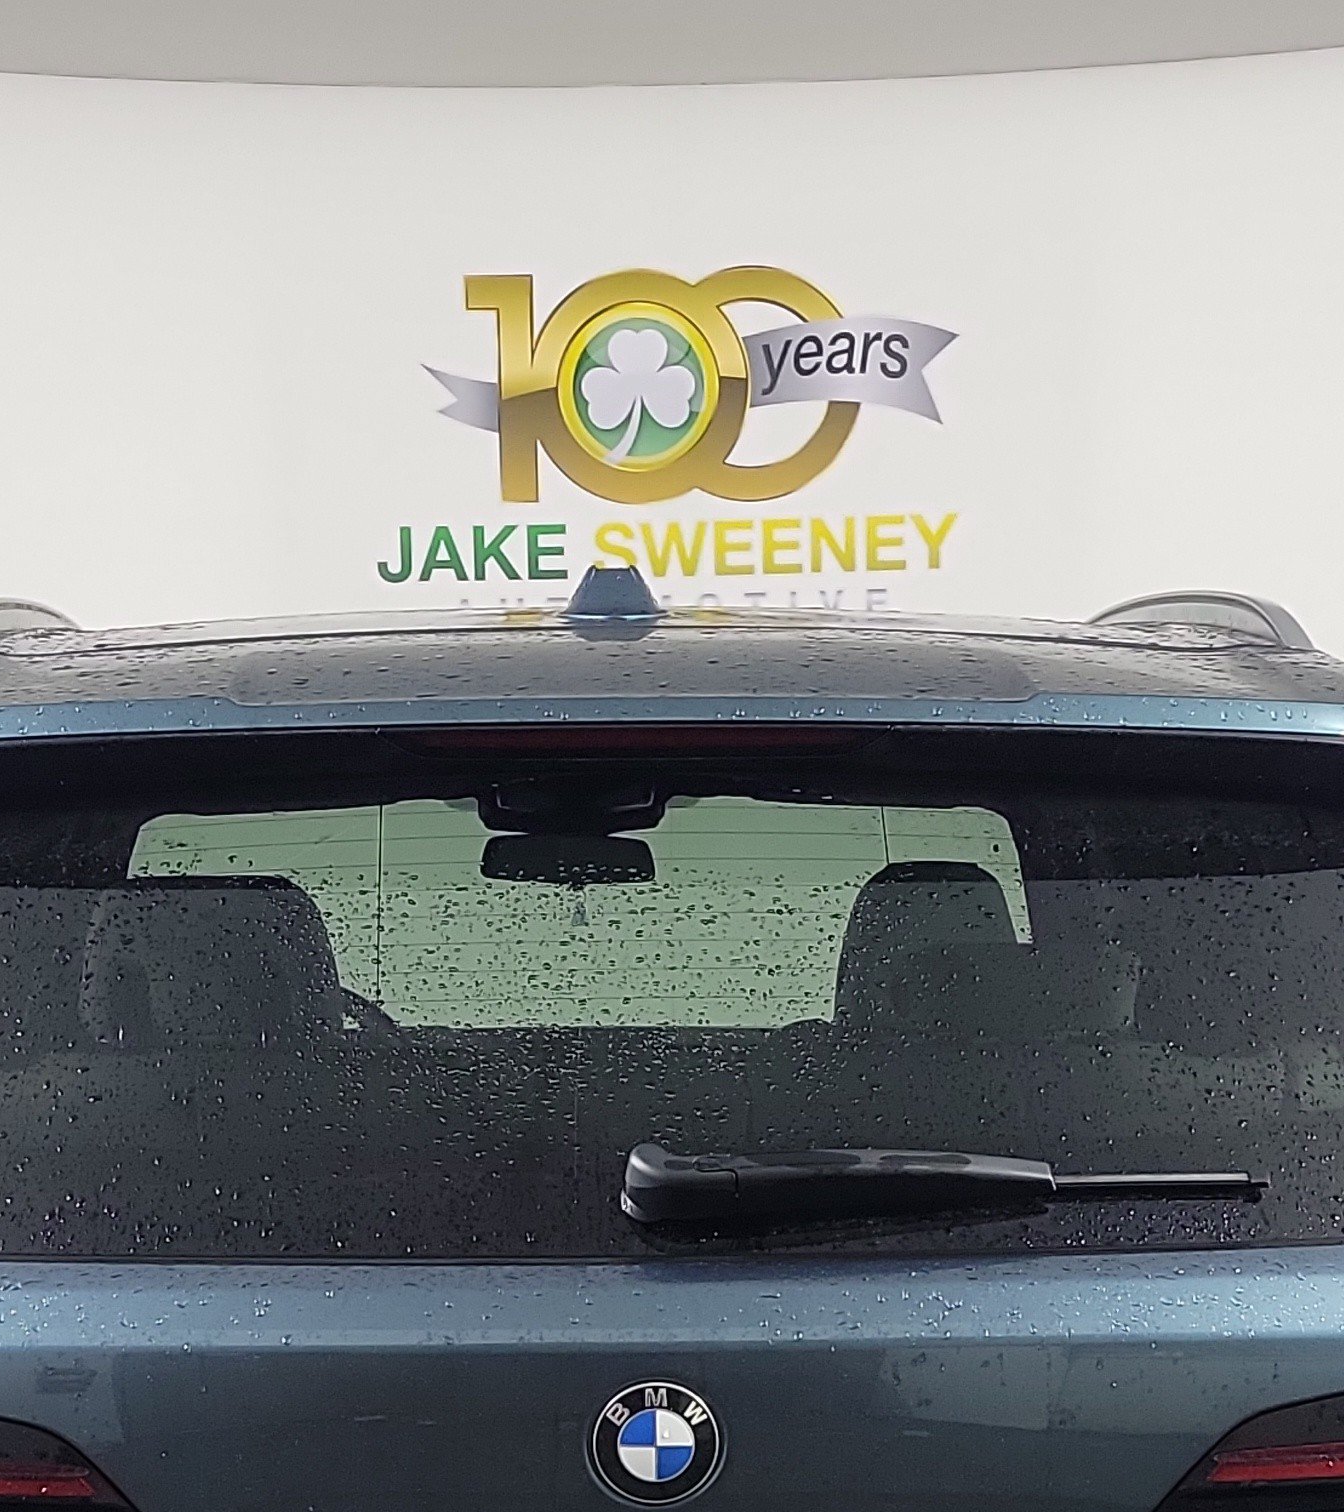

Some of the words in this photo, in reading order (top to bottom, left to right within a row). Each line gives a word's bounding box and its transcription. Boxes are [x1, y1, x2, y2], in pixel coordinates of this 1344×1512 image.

[463, 265, 861, 504] 100
[762, 329, 910, 396] years
[377, 524, 569, 584] JAKE
[594, 513, 958, 578] SWEENEY
[606, 1387, 708, 1427] BMW
